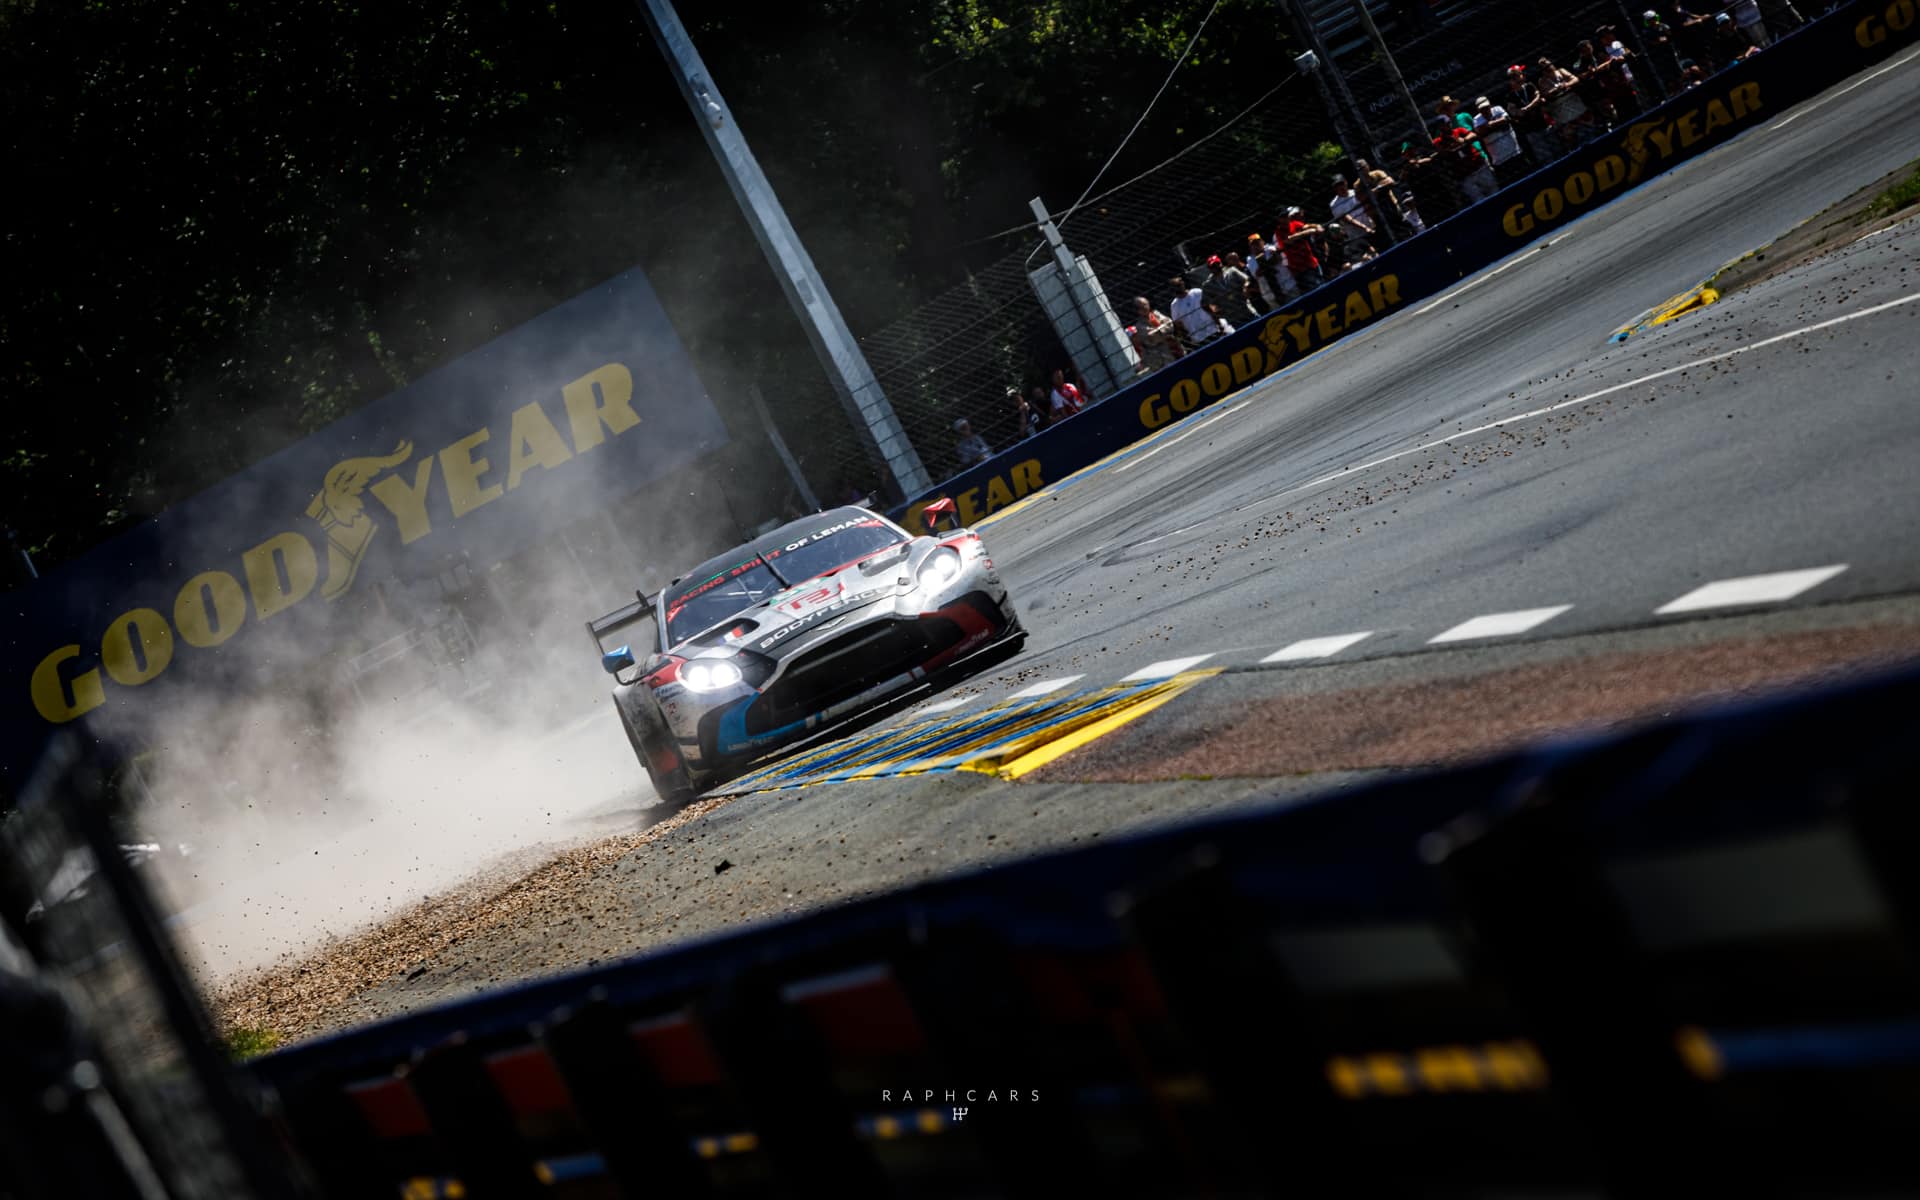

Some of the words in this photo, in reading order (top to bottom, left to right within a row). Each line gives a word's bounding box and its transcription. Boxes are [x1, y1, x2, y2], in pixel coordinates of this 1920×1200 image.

[1855, 0, 1920, 48] GO
[669, 575, 726, 611] RACING
[785, 536, 809, 552] OF
[812, 515, 869, 541] LEMAN
[759, 586, 886, 649] BODYFENC
